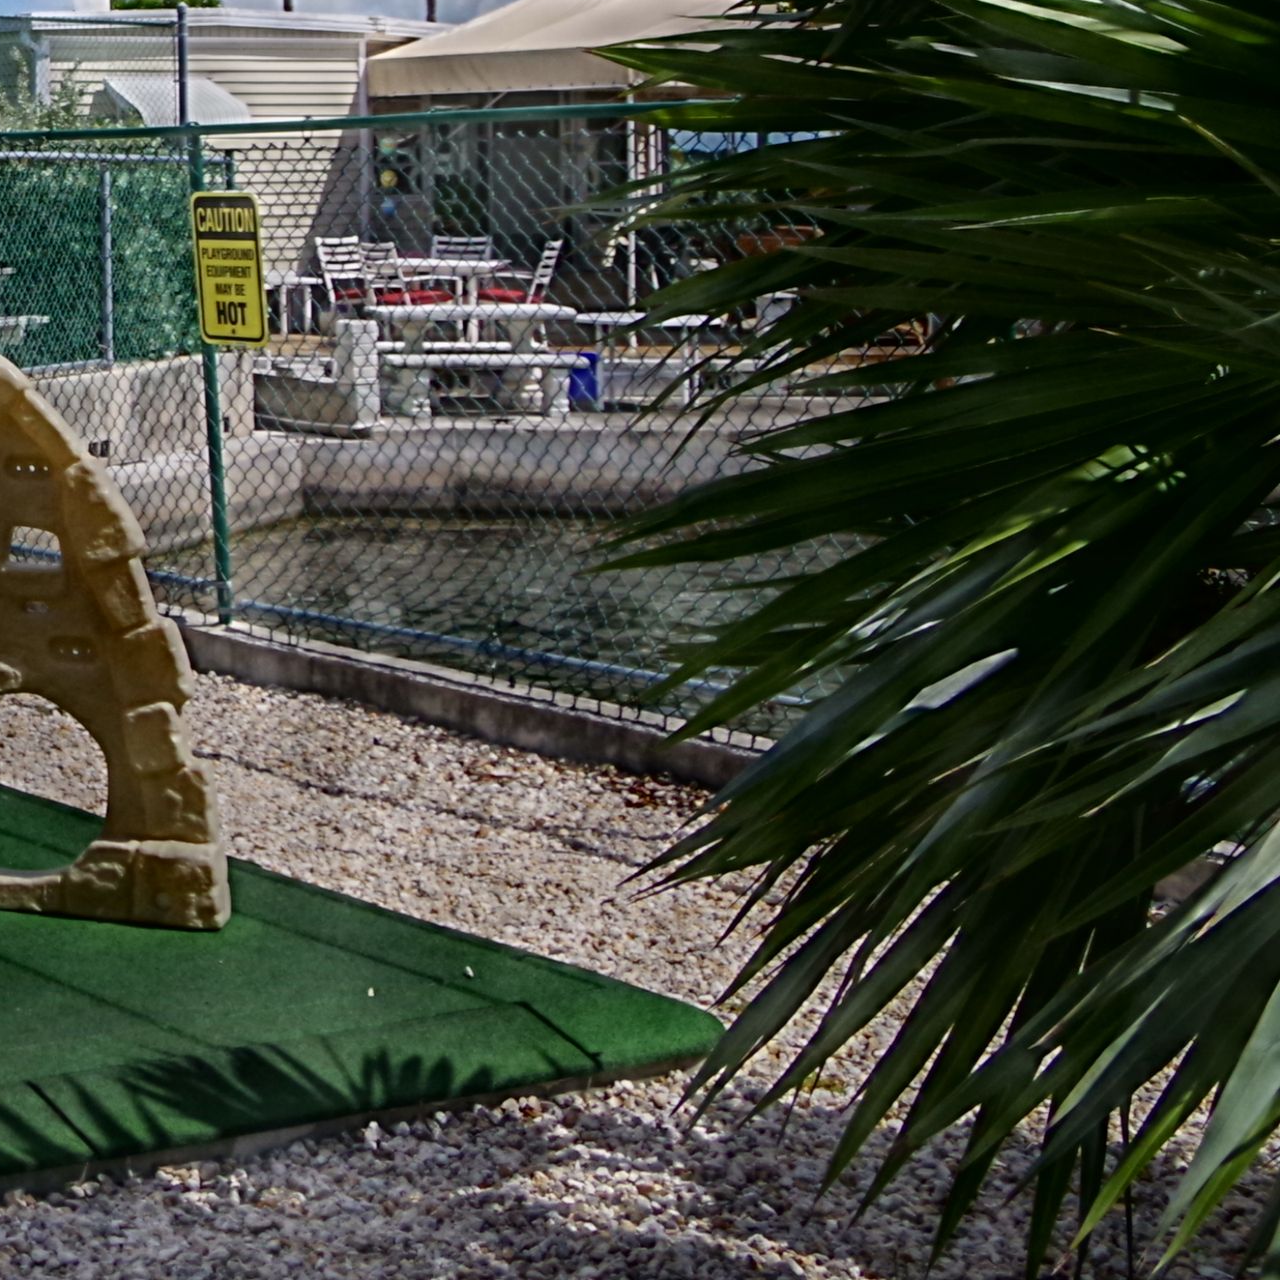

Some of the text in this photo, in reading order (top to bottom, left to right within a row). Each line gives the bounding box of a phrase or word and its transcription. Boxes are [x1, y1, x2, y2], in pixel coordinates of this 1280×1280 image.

[196, 207, 255, 232] CAUTION
[201, 248, 254, 261] PLAYGROUND
[206, 265, 251, 278] EQUIPMENT
[215, 283, 246, 296] MAY BE
[216, 301, 247, 326] HOT
